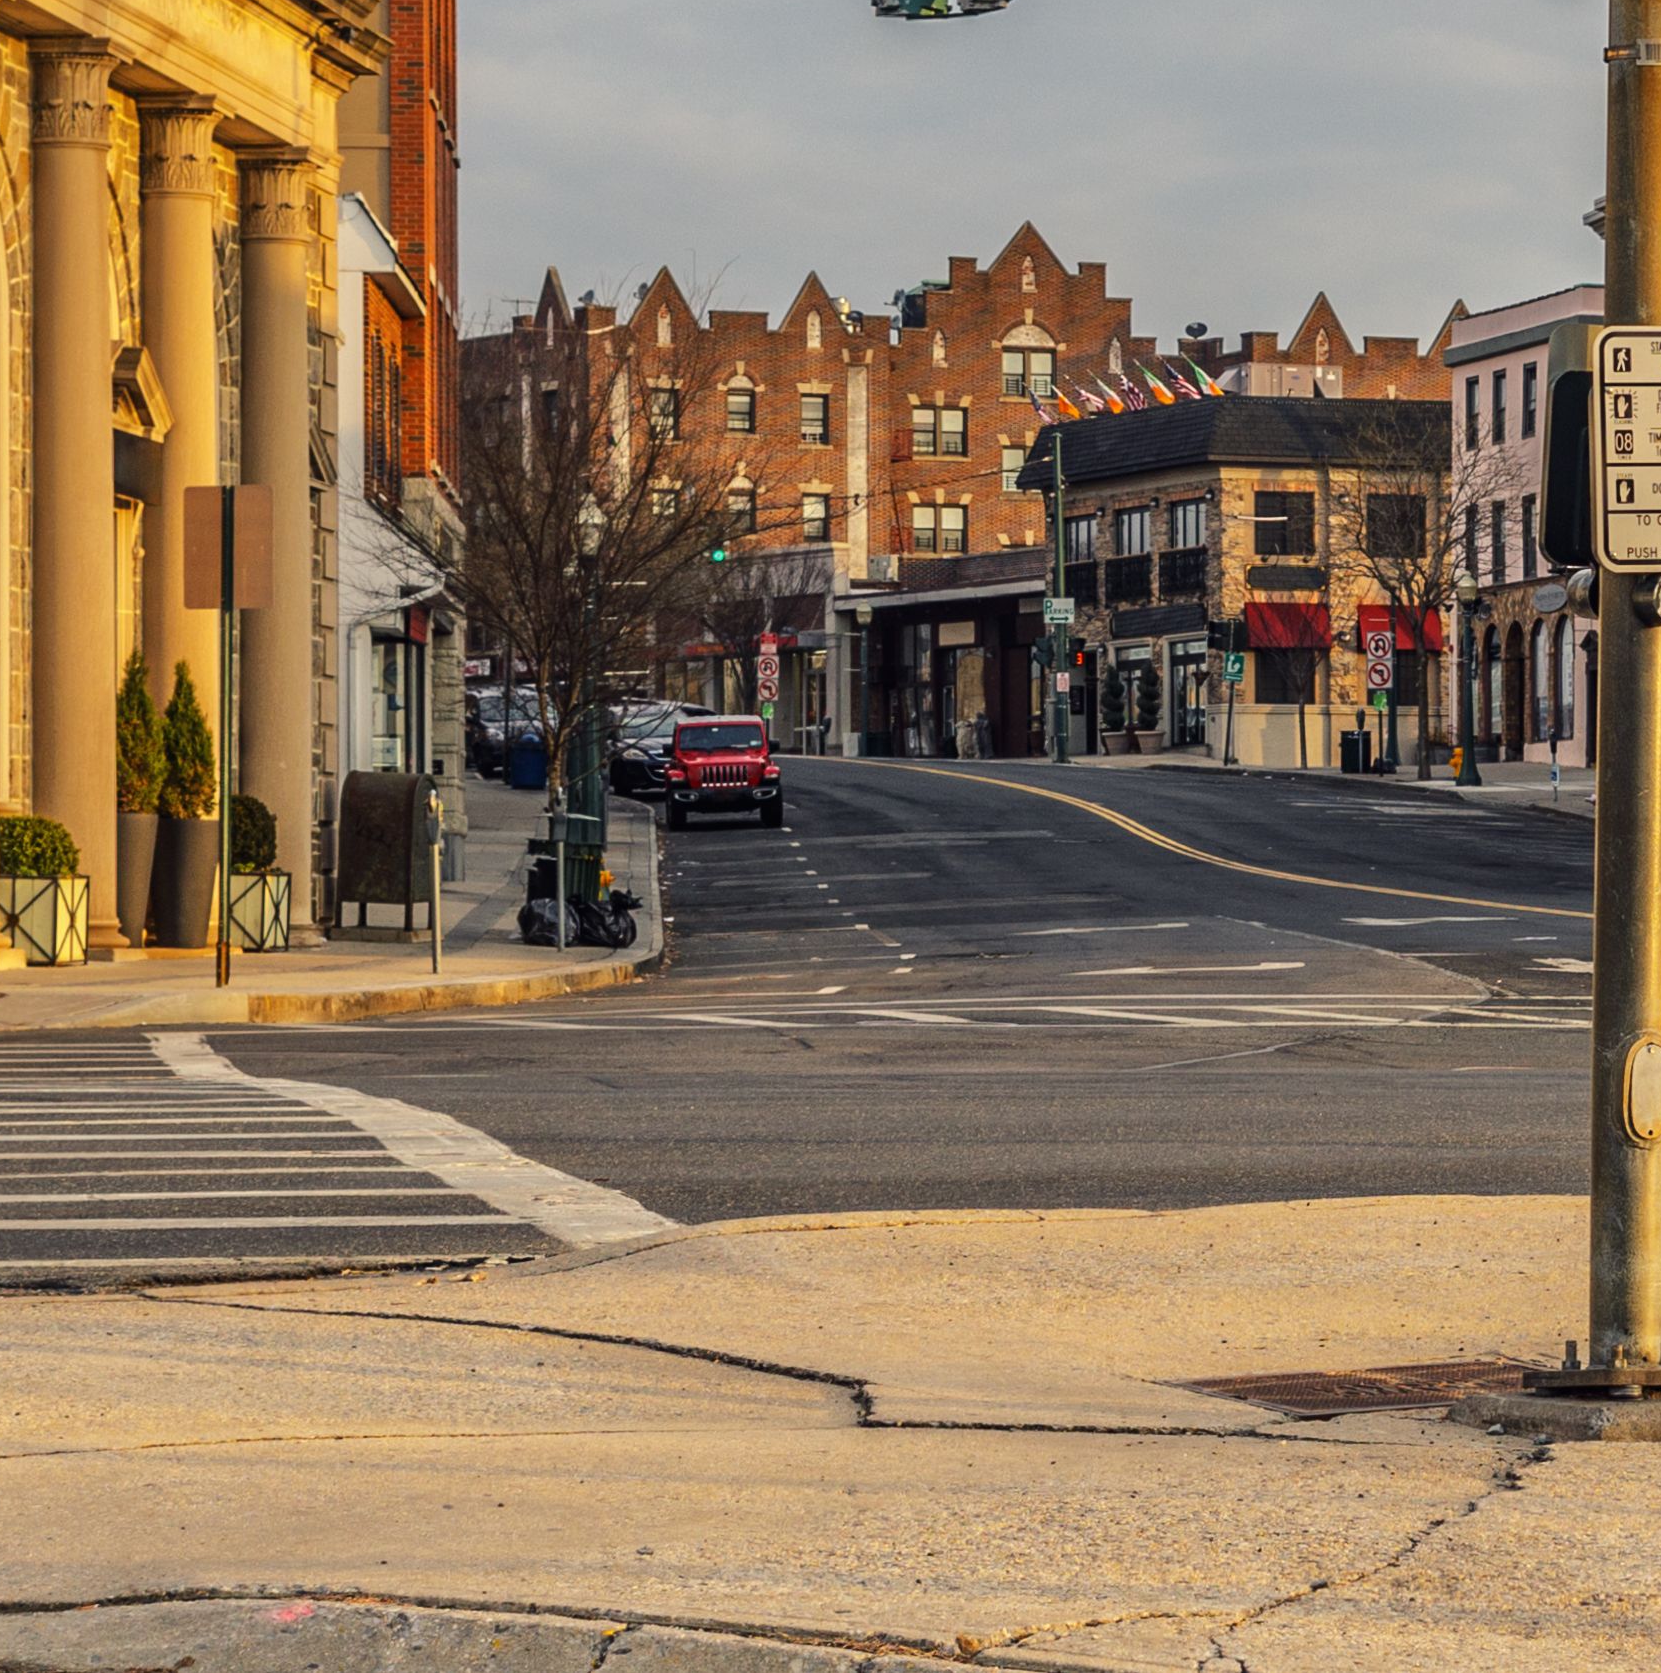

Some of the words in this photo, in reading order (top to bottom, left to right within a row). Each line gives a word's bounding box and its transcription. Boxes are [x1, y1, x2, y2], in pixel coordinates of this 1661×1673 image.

[1615, 432, 1633, 451] 08
[1636, 514, 1651, 526] TO
[1626, 546, 1658, 558] PUSH
